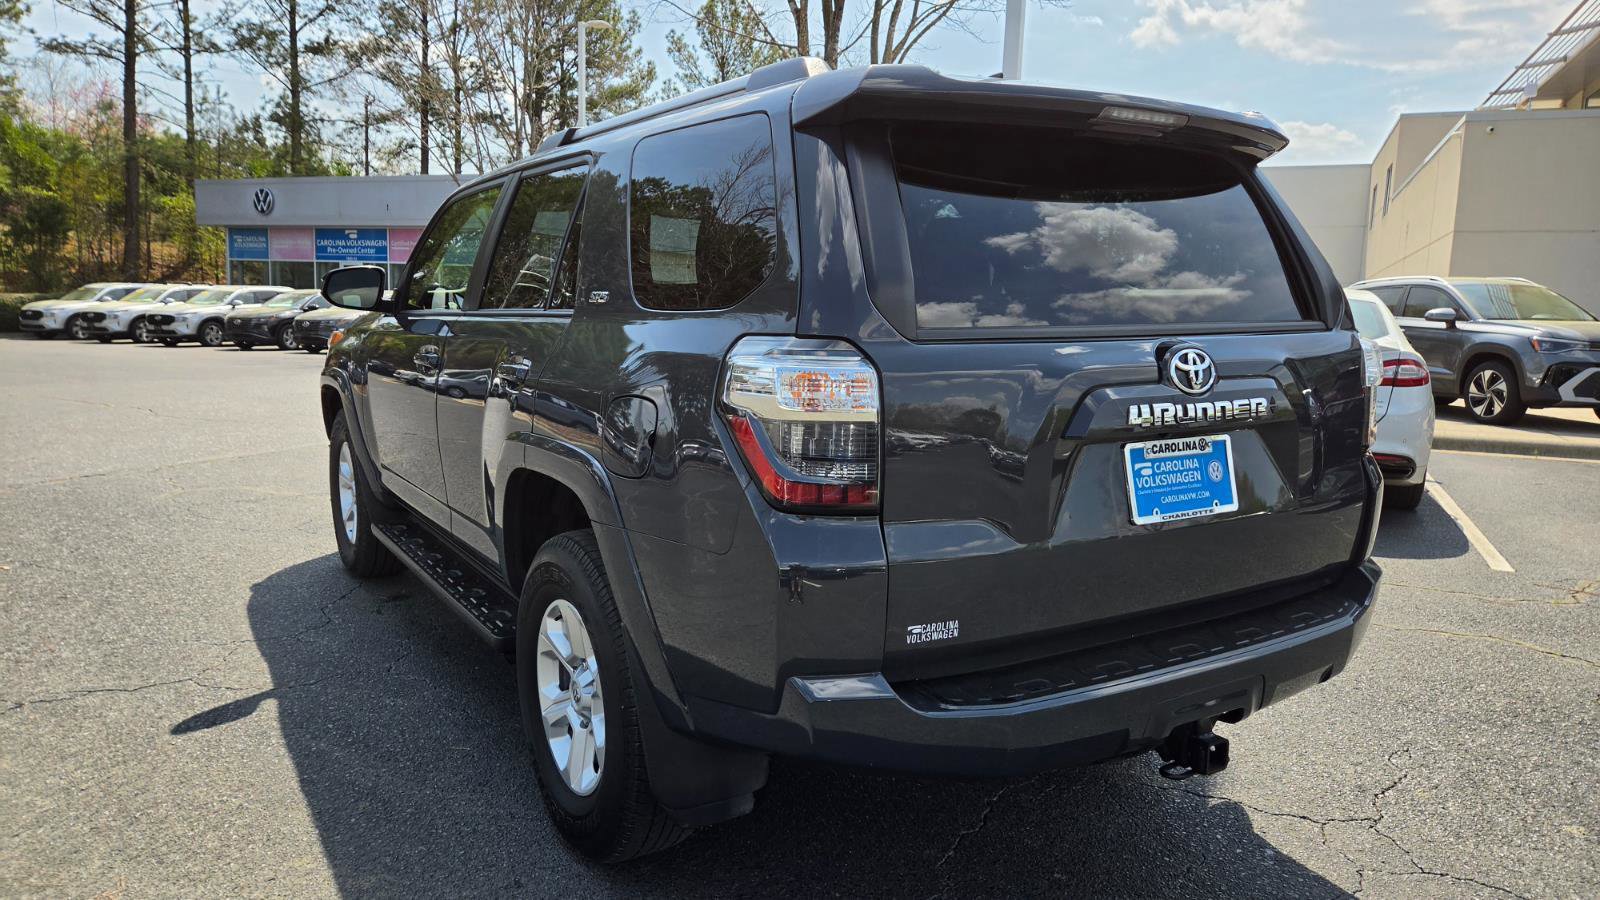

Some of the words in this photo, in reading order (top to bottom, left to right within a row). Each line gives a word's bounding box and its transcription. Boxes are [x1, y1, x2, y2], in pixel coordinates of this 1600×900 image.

[1128, 397, 1268, 427] 4RUNNER
[1151, 440, 1197, 455] CAROLINA
[1154, 458, 1200, 473] CAROLINA
[1135, 470, 1202, 489] VOLKSWAGEN
[1160, 490, 1211, 504] CAROLINAVW.COM
[1162, 508, 1214, 521] CHARLOTTE
[921, 620, 959, 634] CAROLINA
[906, 628, 959, 644] VOLKSWAGEN
